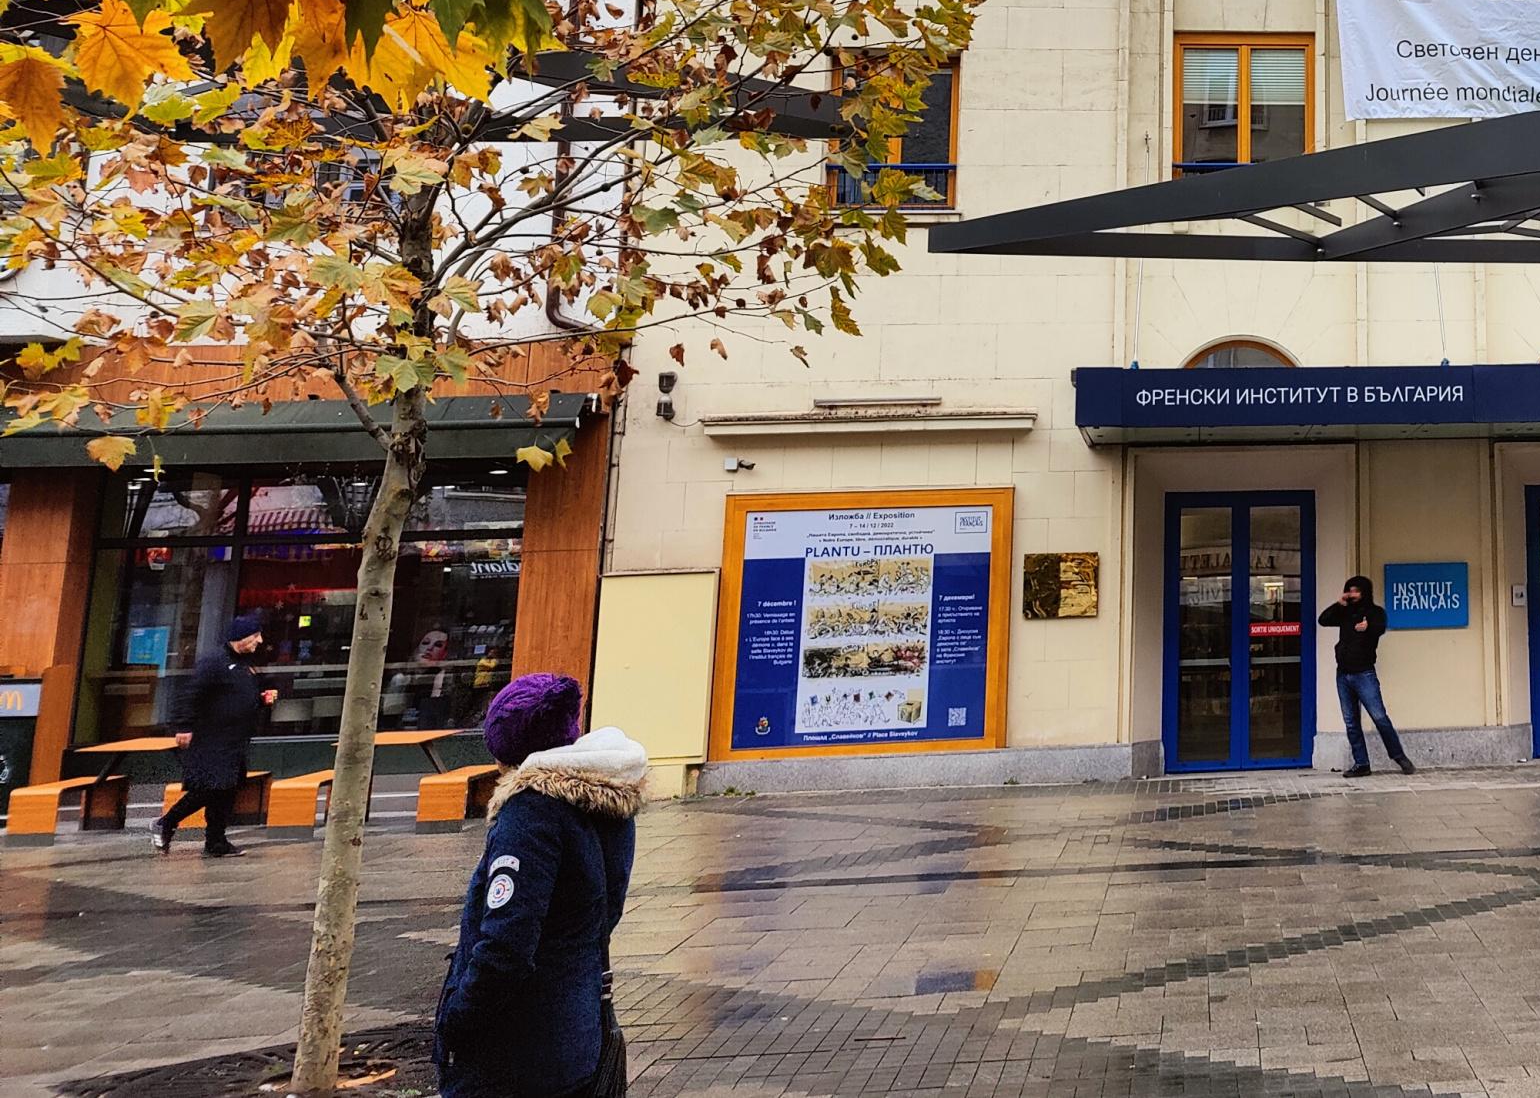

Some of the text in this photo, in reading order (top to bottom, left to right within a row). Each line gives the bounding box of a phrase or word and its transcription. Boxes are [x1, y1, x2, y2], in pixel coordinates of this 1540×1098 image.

[1396, 39, 1499, 61] Световен
[1365, 82, 1449, 102] Journée
[1136, 385, 1464, 406] ФРЕНСКИ ИНСТИТУТ В БЪЛГАРИЯ
[828, 513, 864, 521] Изложба
[873, 512, 915, 521] Exposition
[805, 545, 860, 558] PLANTU
[874, 543, 934, 555] ПЛАНТЮ
[1393, 581, 1453, 597] INSTITUT
[1251, 624, 1300, 633] SORTIE UNIQUEMENT
